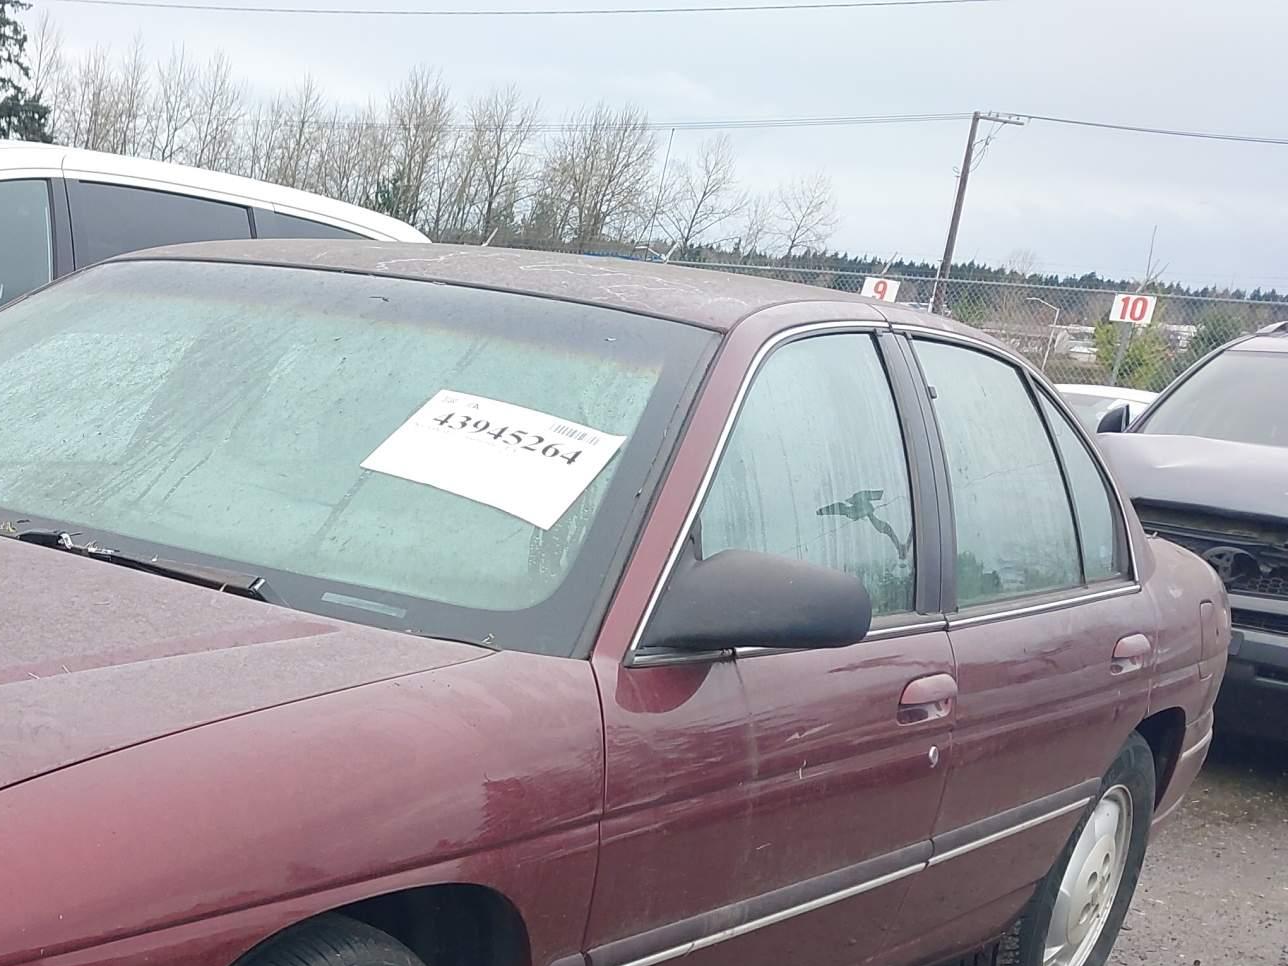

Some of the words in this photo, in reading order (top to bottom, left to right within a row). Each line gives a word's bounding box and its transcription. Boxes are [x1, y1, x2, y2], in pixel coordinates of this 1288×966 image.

[873, 280, 888, 301] 9
[1119, 296, 1148, 321] 10
[433, 412, 583, 465] 43945264
